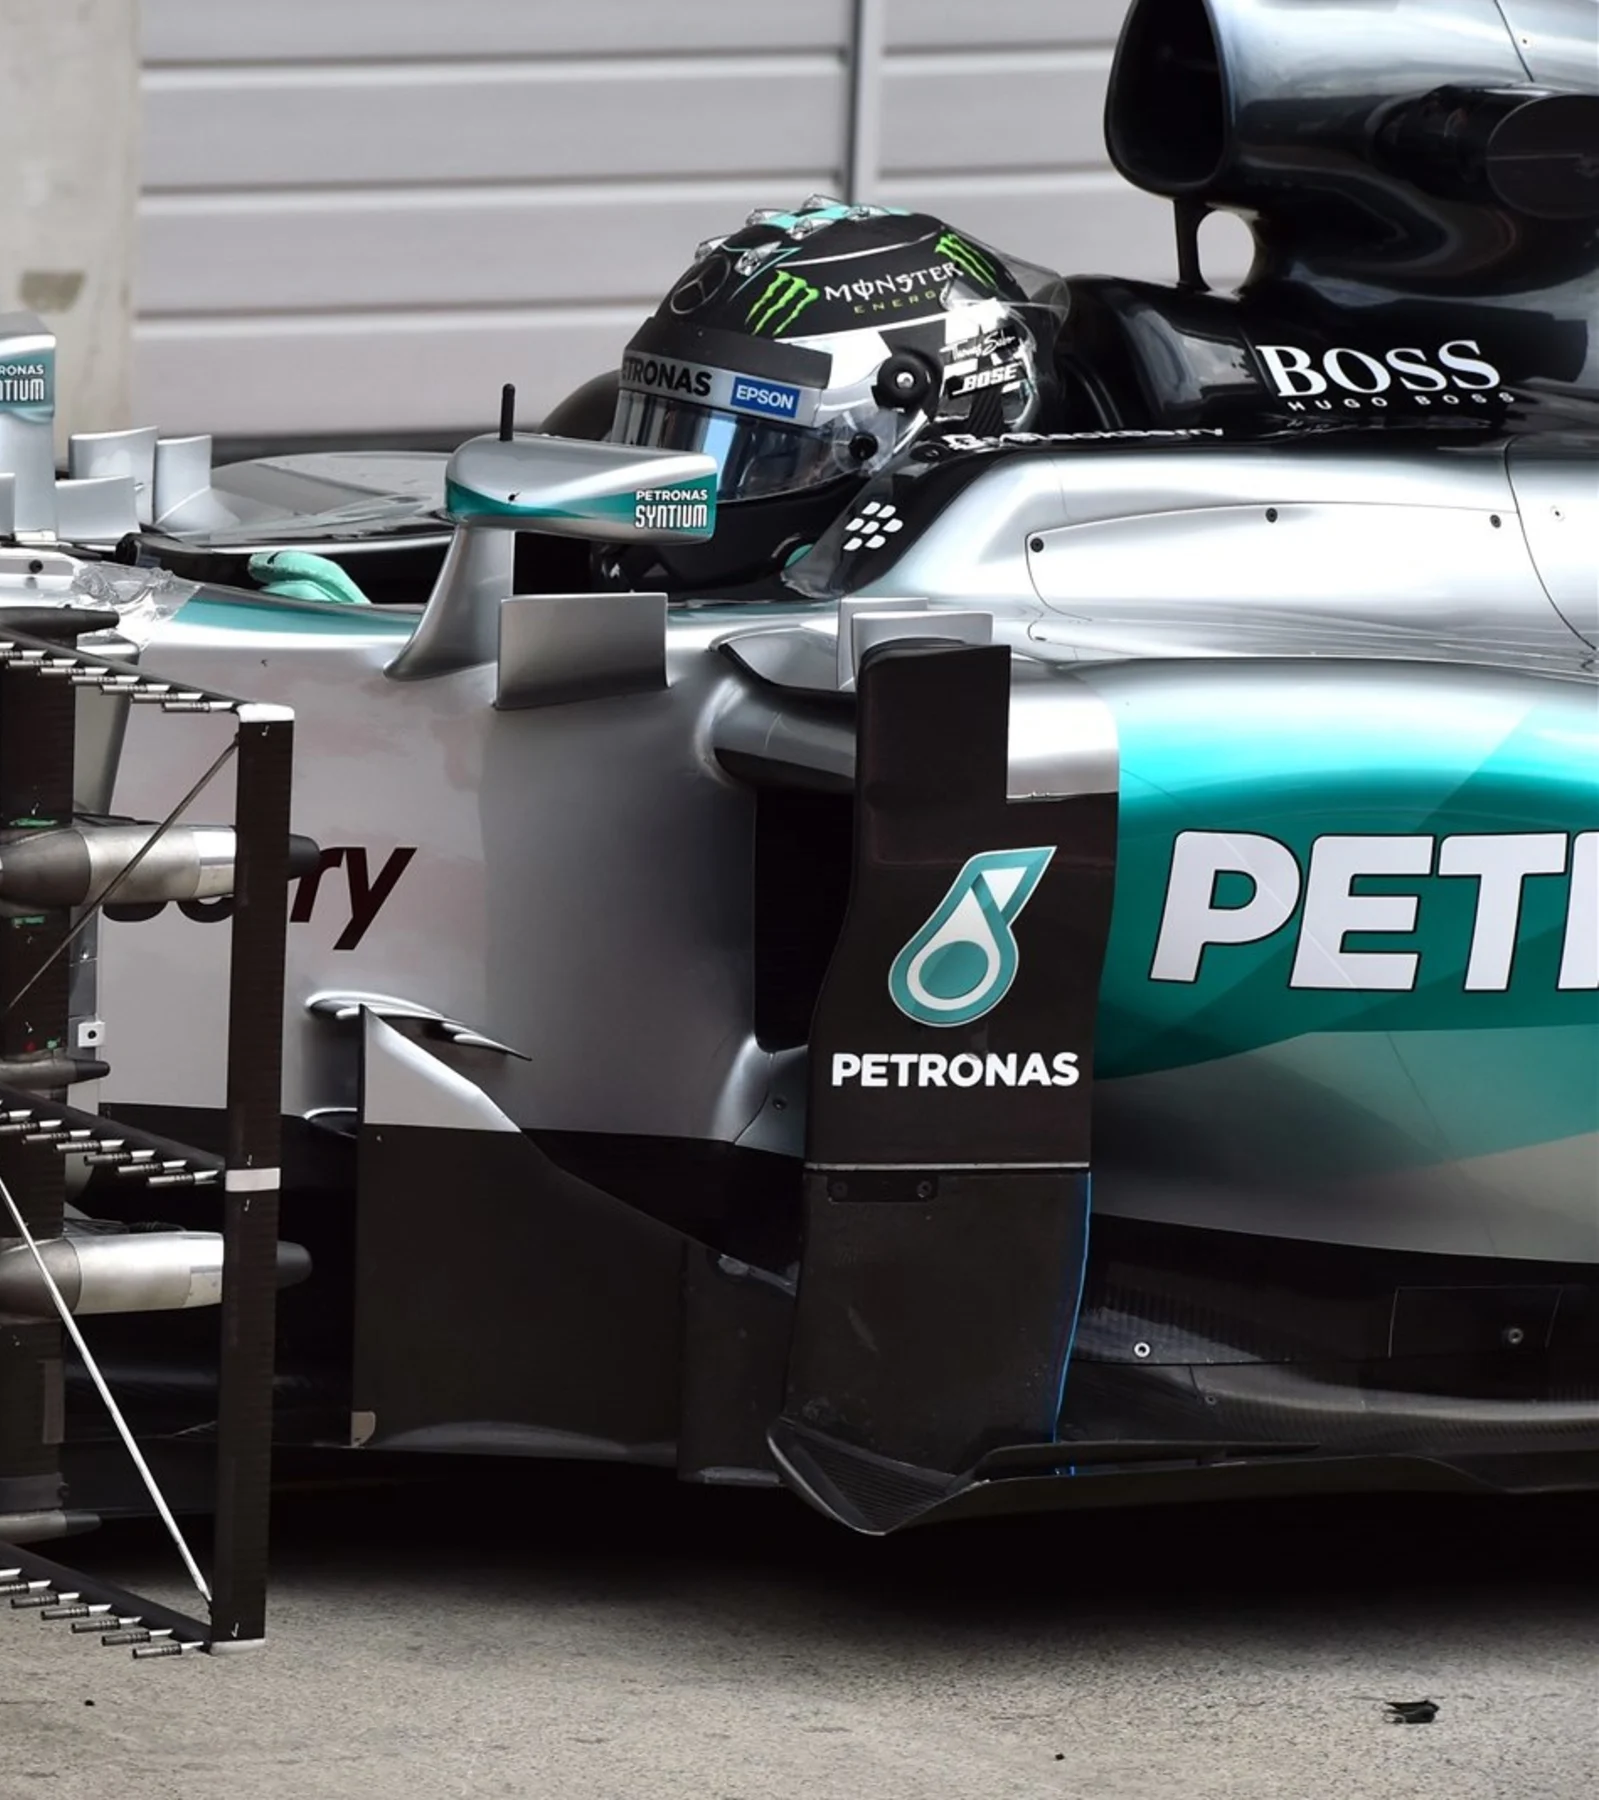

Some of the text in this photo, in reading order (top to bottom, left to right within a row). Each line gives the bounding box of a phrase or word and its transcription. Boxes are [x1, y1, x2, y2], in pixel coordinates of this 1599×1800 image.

[824, 261, 964, 302] MONSTER
[853, 290, 937, 314] ENERG
[951, 360, 1023, 395] BOSE
[1255, 340, 1500, 397] BOSS
[736, 384, 794, 410] EPSON
[1287, 392, 1515, 411] HUGO BOSS
[635, 489, 708, 501] PETRONAS
[635, 504, 708, 528] SYNTIUM
[1148, 829, 1599, 992] PET
[831, 1052, 1080, 1088] PETRONAS
